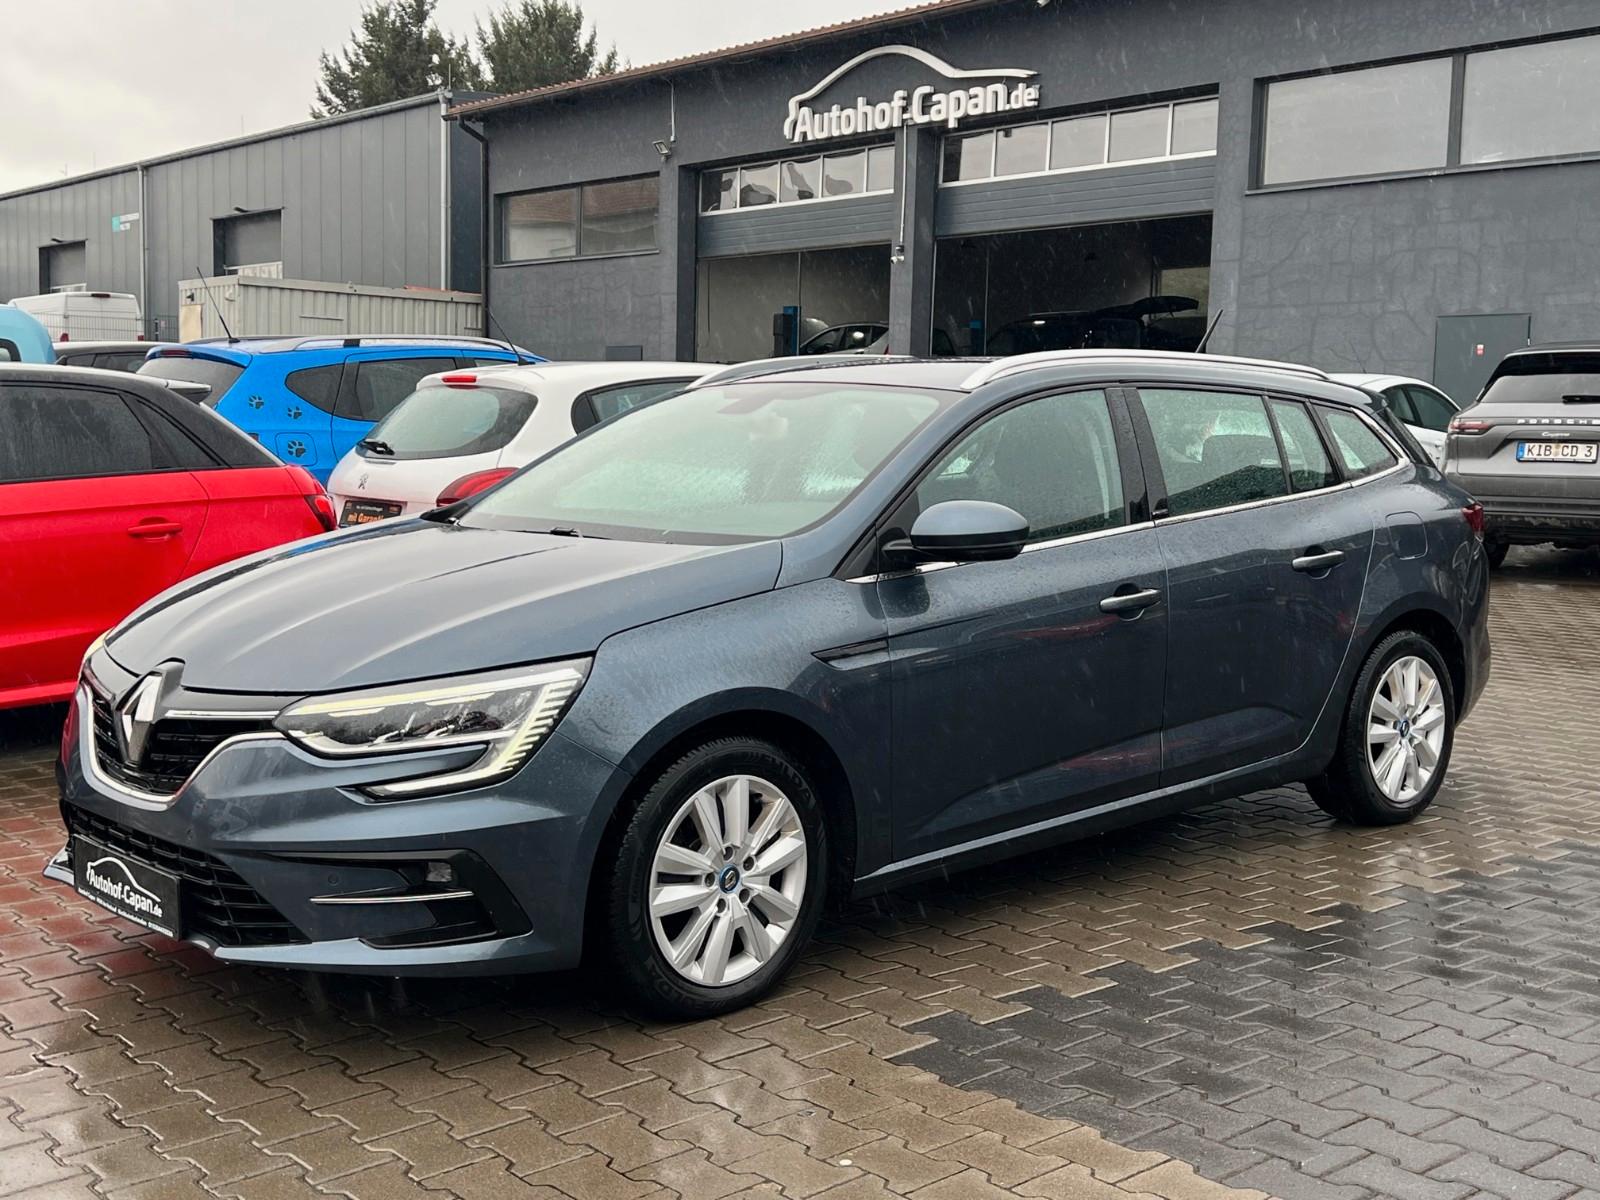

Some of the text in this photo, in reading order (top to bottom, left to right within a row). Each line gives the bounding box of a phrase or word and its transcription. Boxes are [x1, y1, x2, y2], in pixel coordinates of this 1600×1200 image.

[1526, 444, 1593, 457] KIB CD 3
